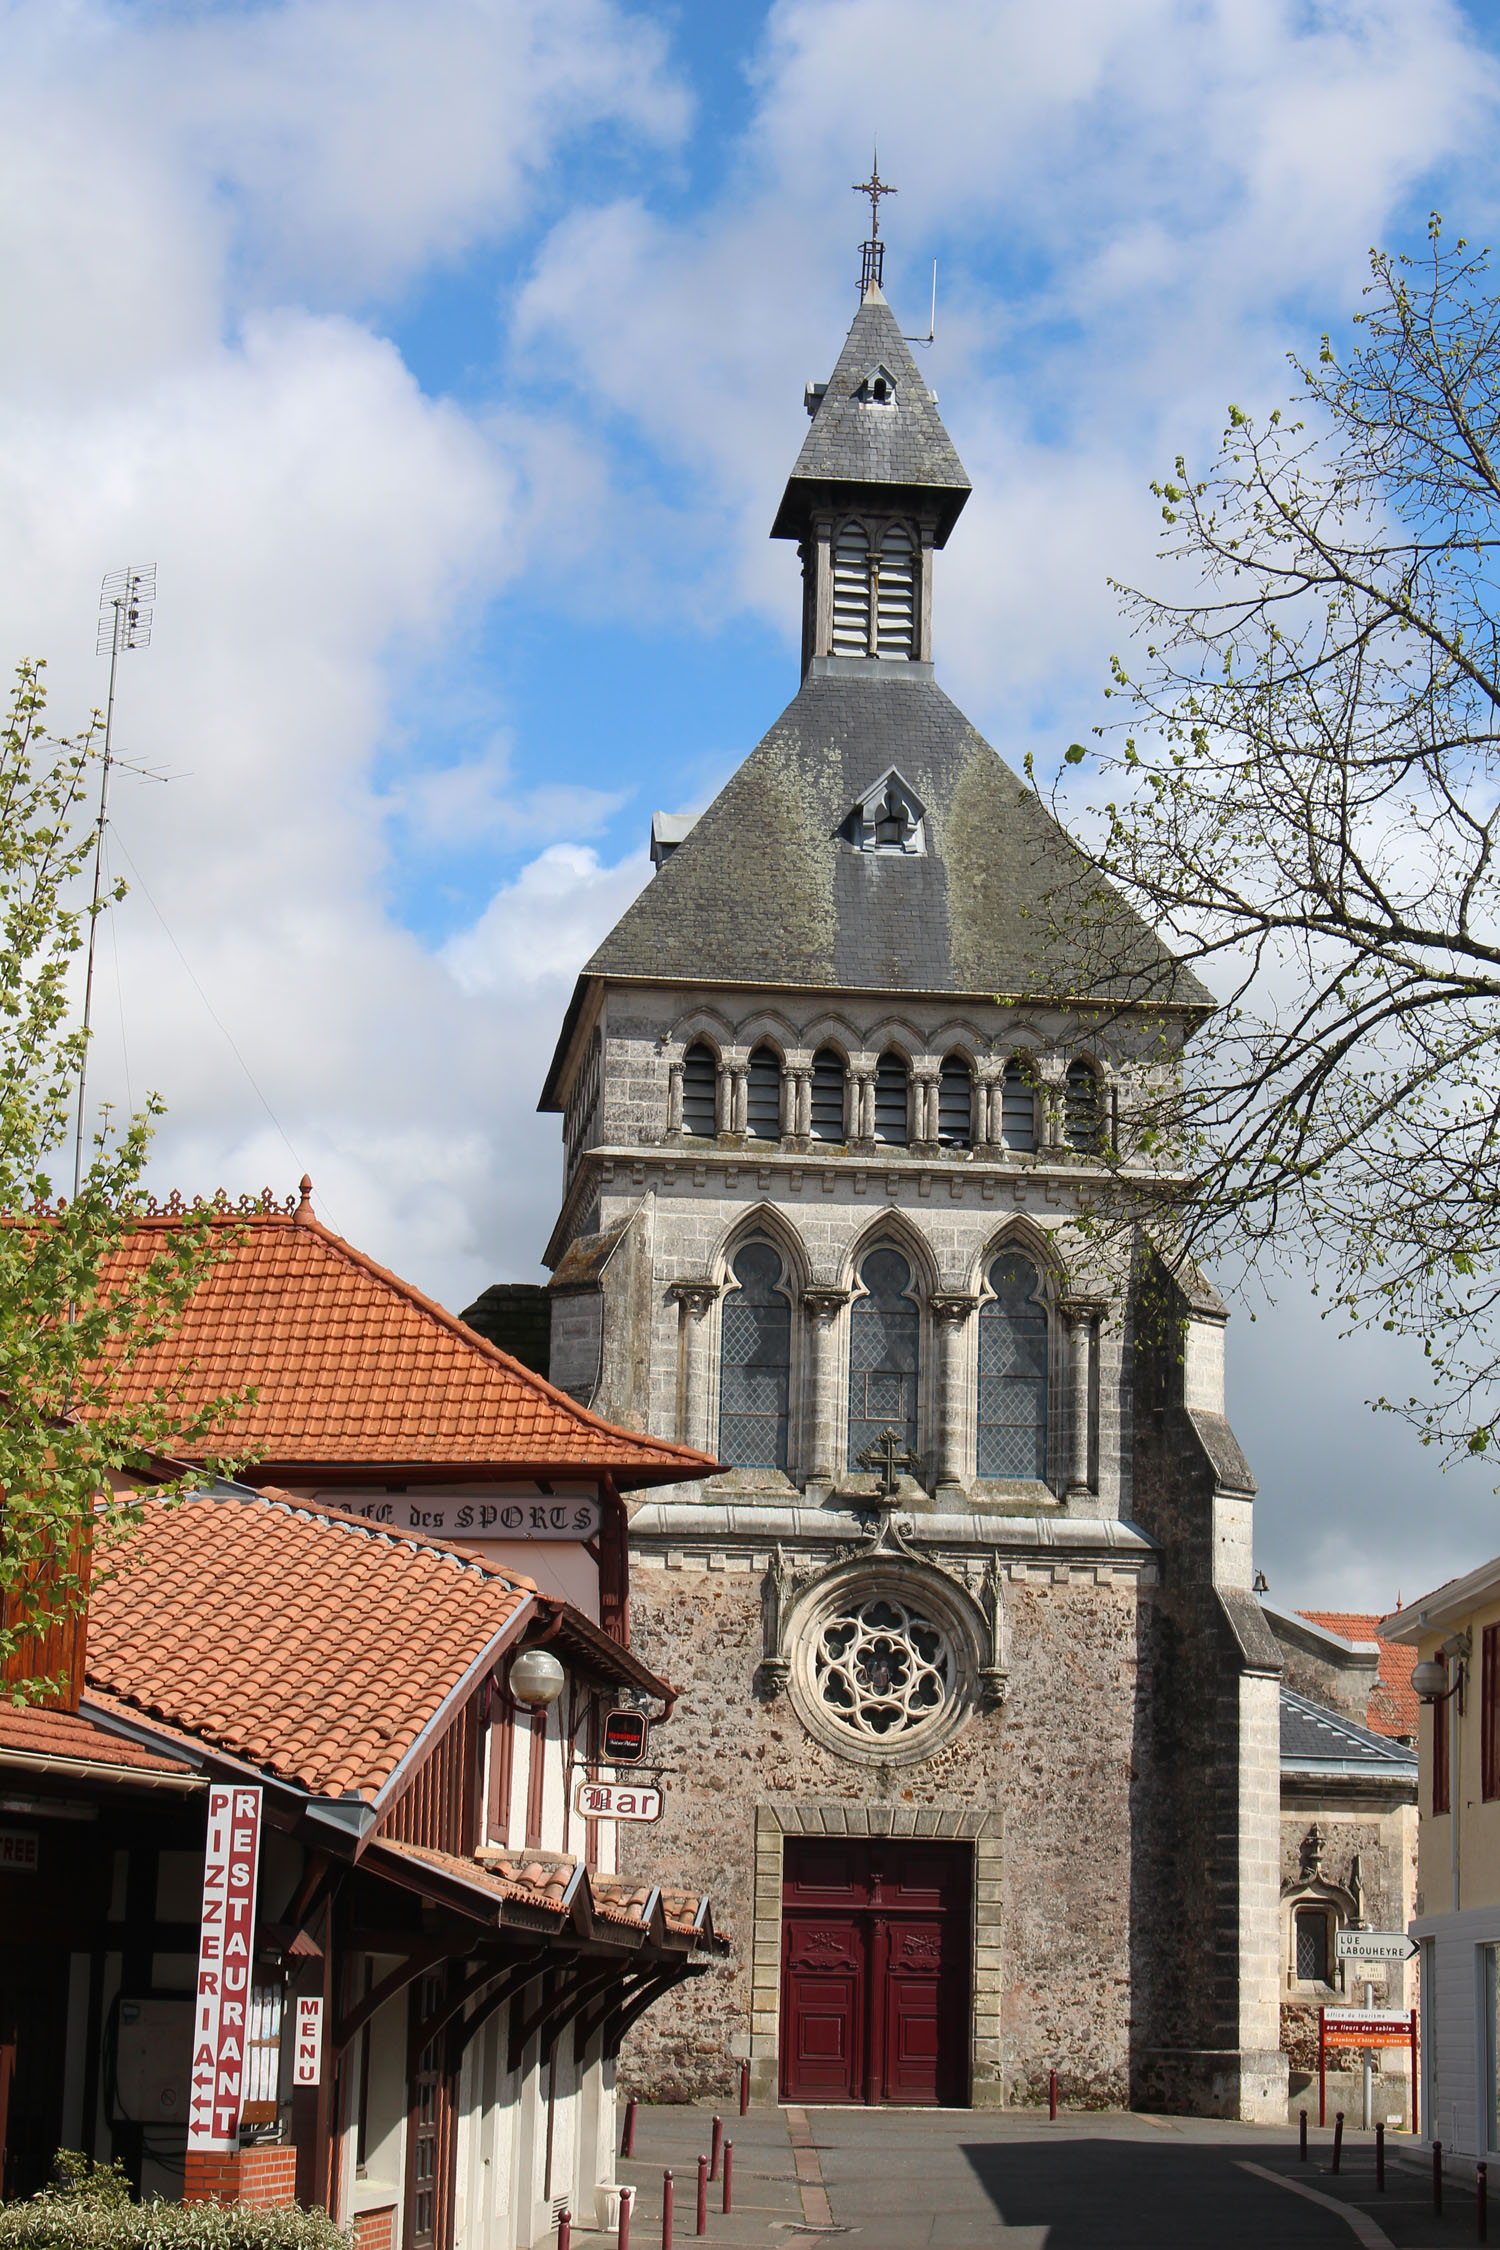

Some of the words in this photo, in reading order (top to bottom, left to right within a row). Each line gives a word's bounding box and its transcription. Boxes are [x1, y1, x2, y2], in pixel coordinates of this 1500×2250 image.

[322, 1503, 394, 1525] FE
[409, 1504, 445, 1528] des
[454, 1505, 592, 1531] SPORTS
[583, 1786, 655, 1815] Bar
[0, 1836, 35, 1862] REE
[194, 1794, 229, 2067] PIZZERIA
[1340, 1934, 1360, 1945] LÜE
[215, 1793, 256, 2133] RESTAURANT
[1340, 1946, 1404, 1957] LABOUHEYRE
[298, 2000, 319, 2081] MENU
[1361, 2024, 1373, 2032] des
